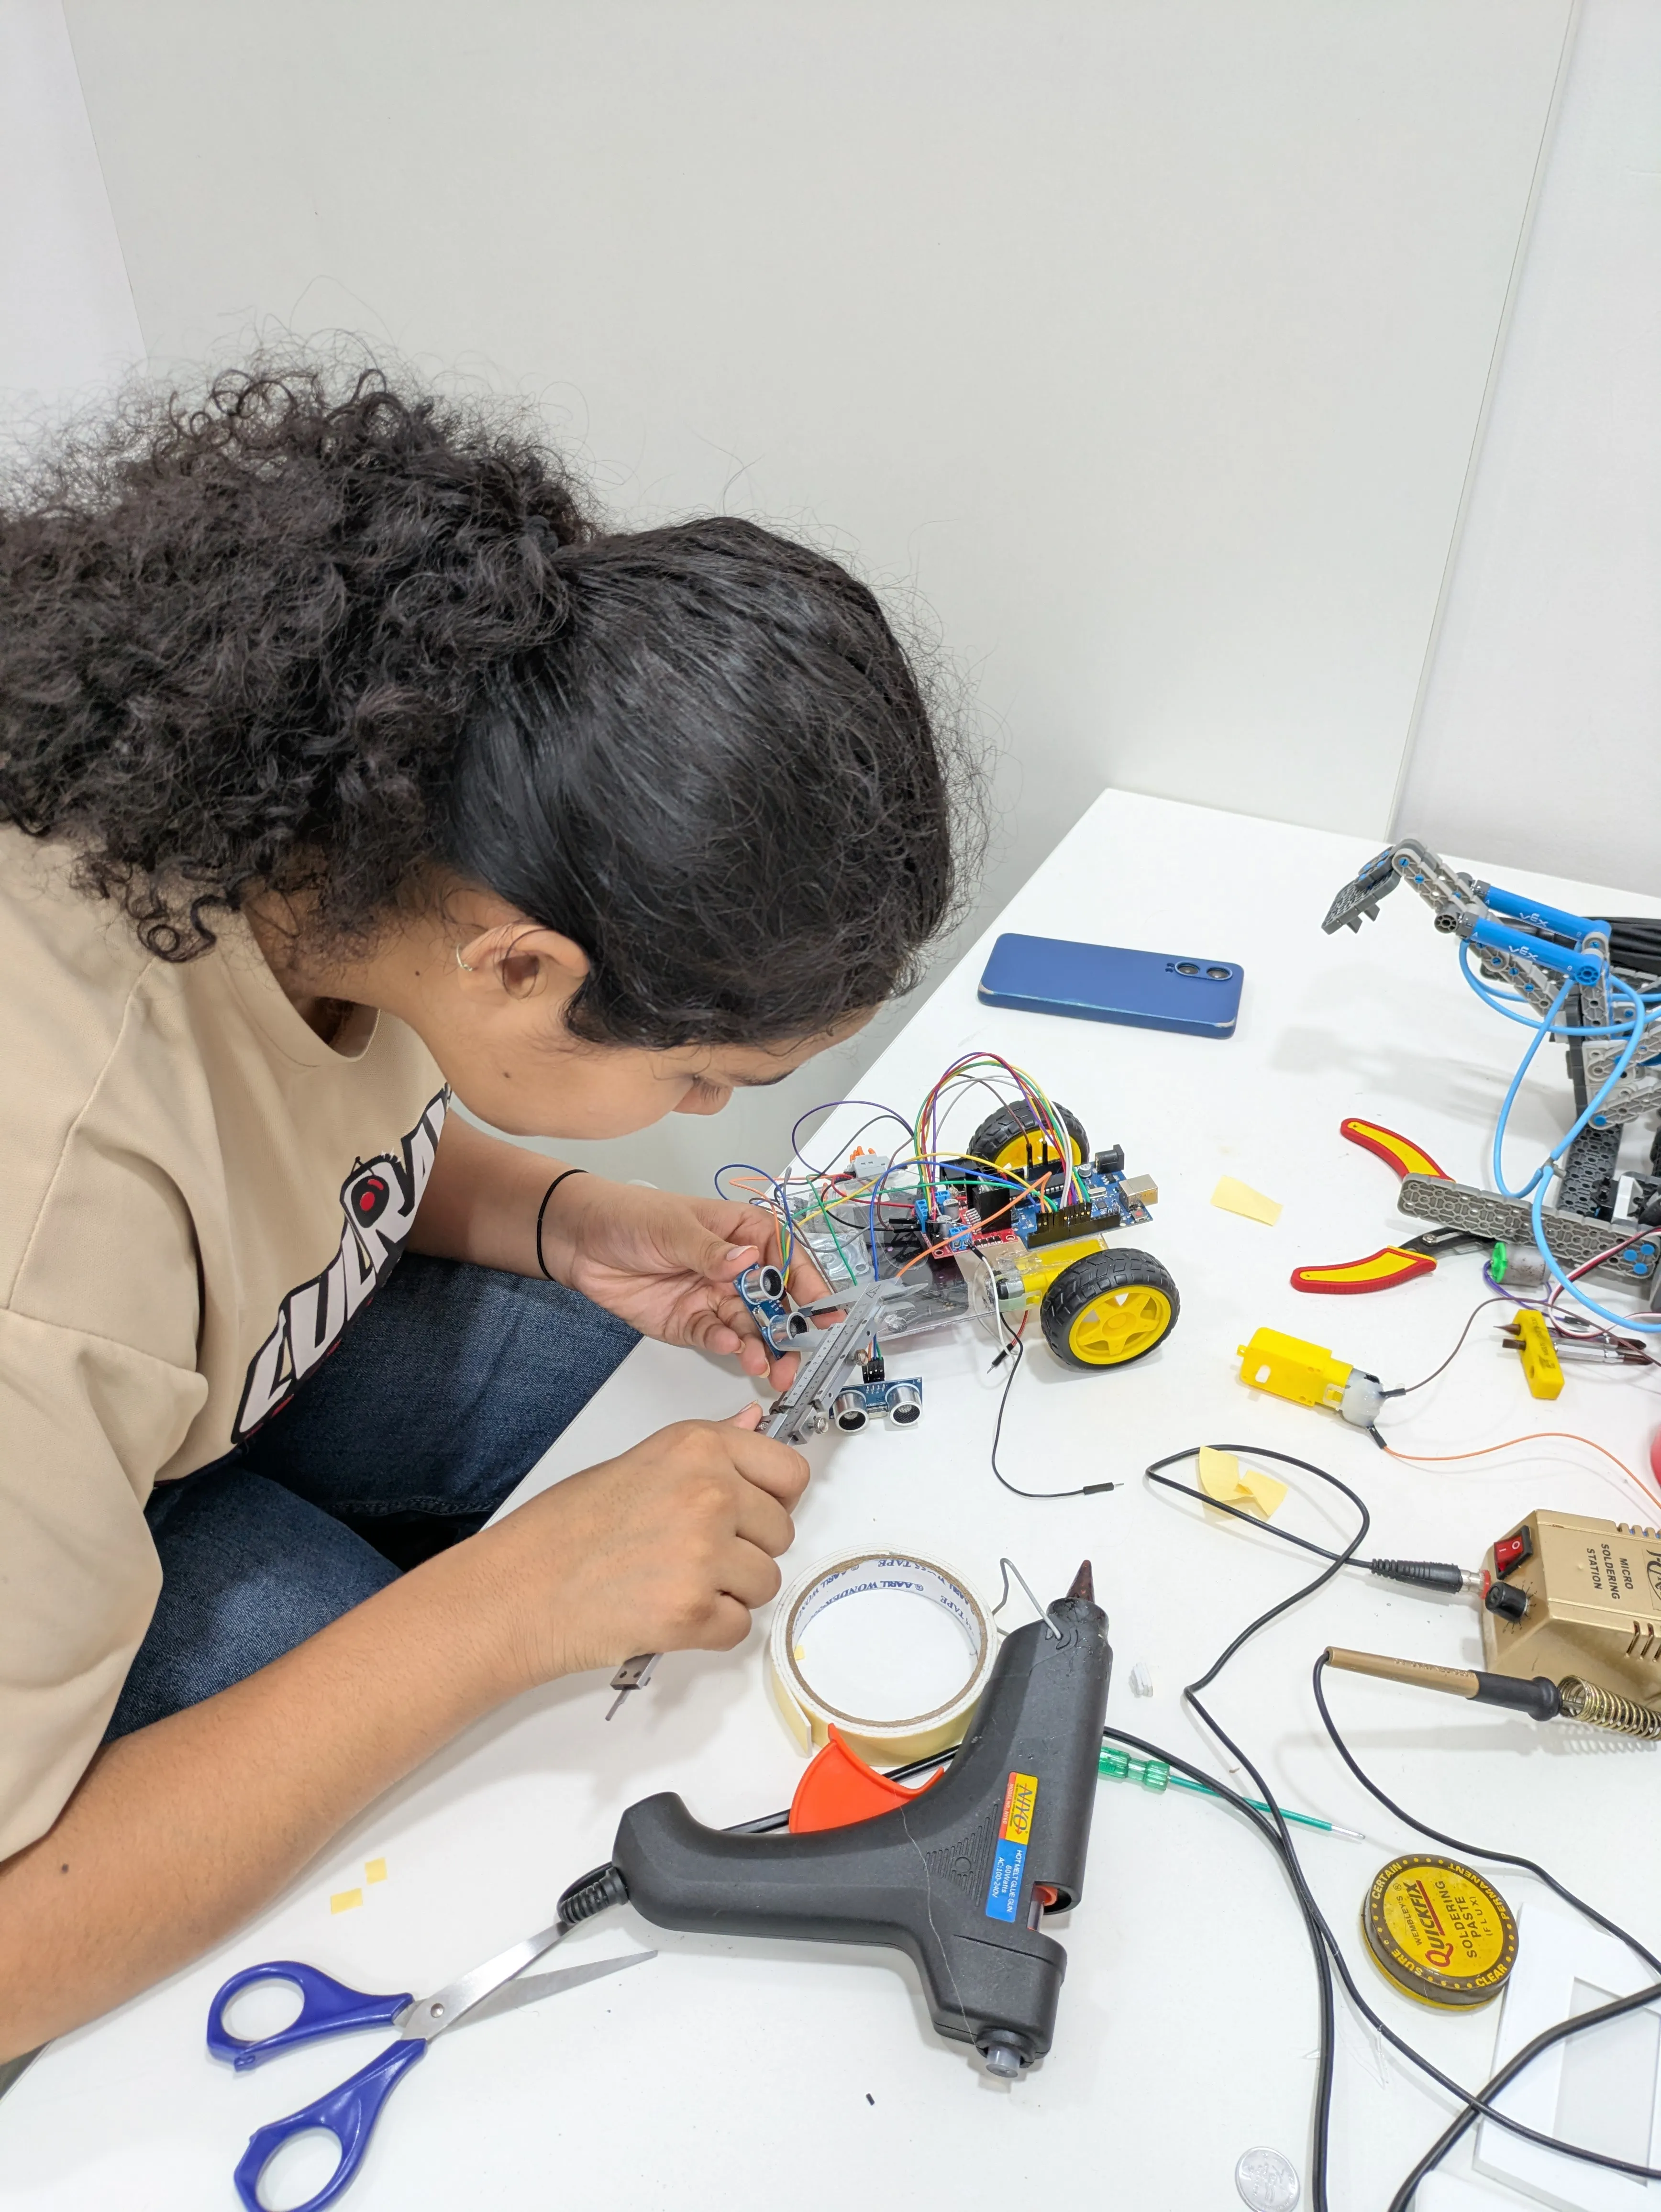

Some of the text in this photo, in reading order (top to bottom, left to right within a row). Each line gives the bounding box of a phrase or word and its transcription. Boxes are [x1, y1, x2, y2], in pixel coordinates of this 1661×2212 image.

[878, 1559, 911, 1568] TAPE
[1586, 1548, 1603, 1590] STATION
[1601, 1543, 1620, 1600] SOLDERING
[1619, 1557, 1634, 1590] MICRO
[940, 1595, 964, 1619] TAPE
[1013, 1785, 1033, 1830] NIYO
[992, 1857, 1006, 1898] AC:100-240V
[1001, 1865, 1012, 1893] 60Watts
[1009, 1880, 1018, 1898] GLUE
[1012, 1863, 1020, 1880] MELT
[1372, 1862, 1403, 1900] CERTAIN
[1448, 1863, 1510, 1920] PERMANENT
[1396, 1895, 1423, 1946] WEMBLEY'S
[1402, 1881, 1454, 1968] QUICKFIX
[1435, 1880, 1478, 1958] SOLDERING
[1454, 1896, 1482, 1938] PASTE
[1391, 1947, 1424, 1977] SURE
[1475, 1963, 1508, 1987] CLEAR
